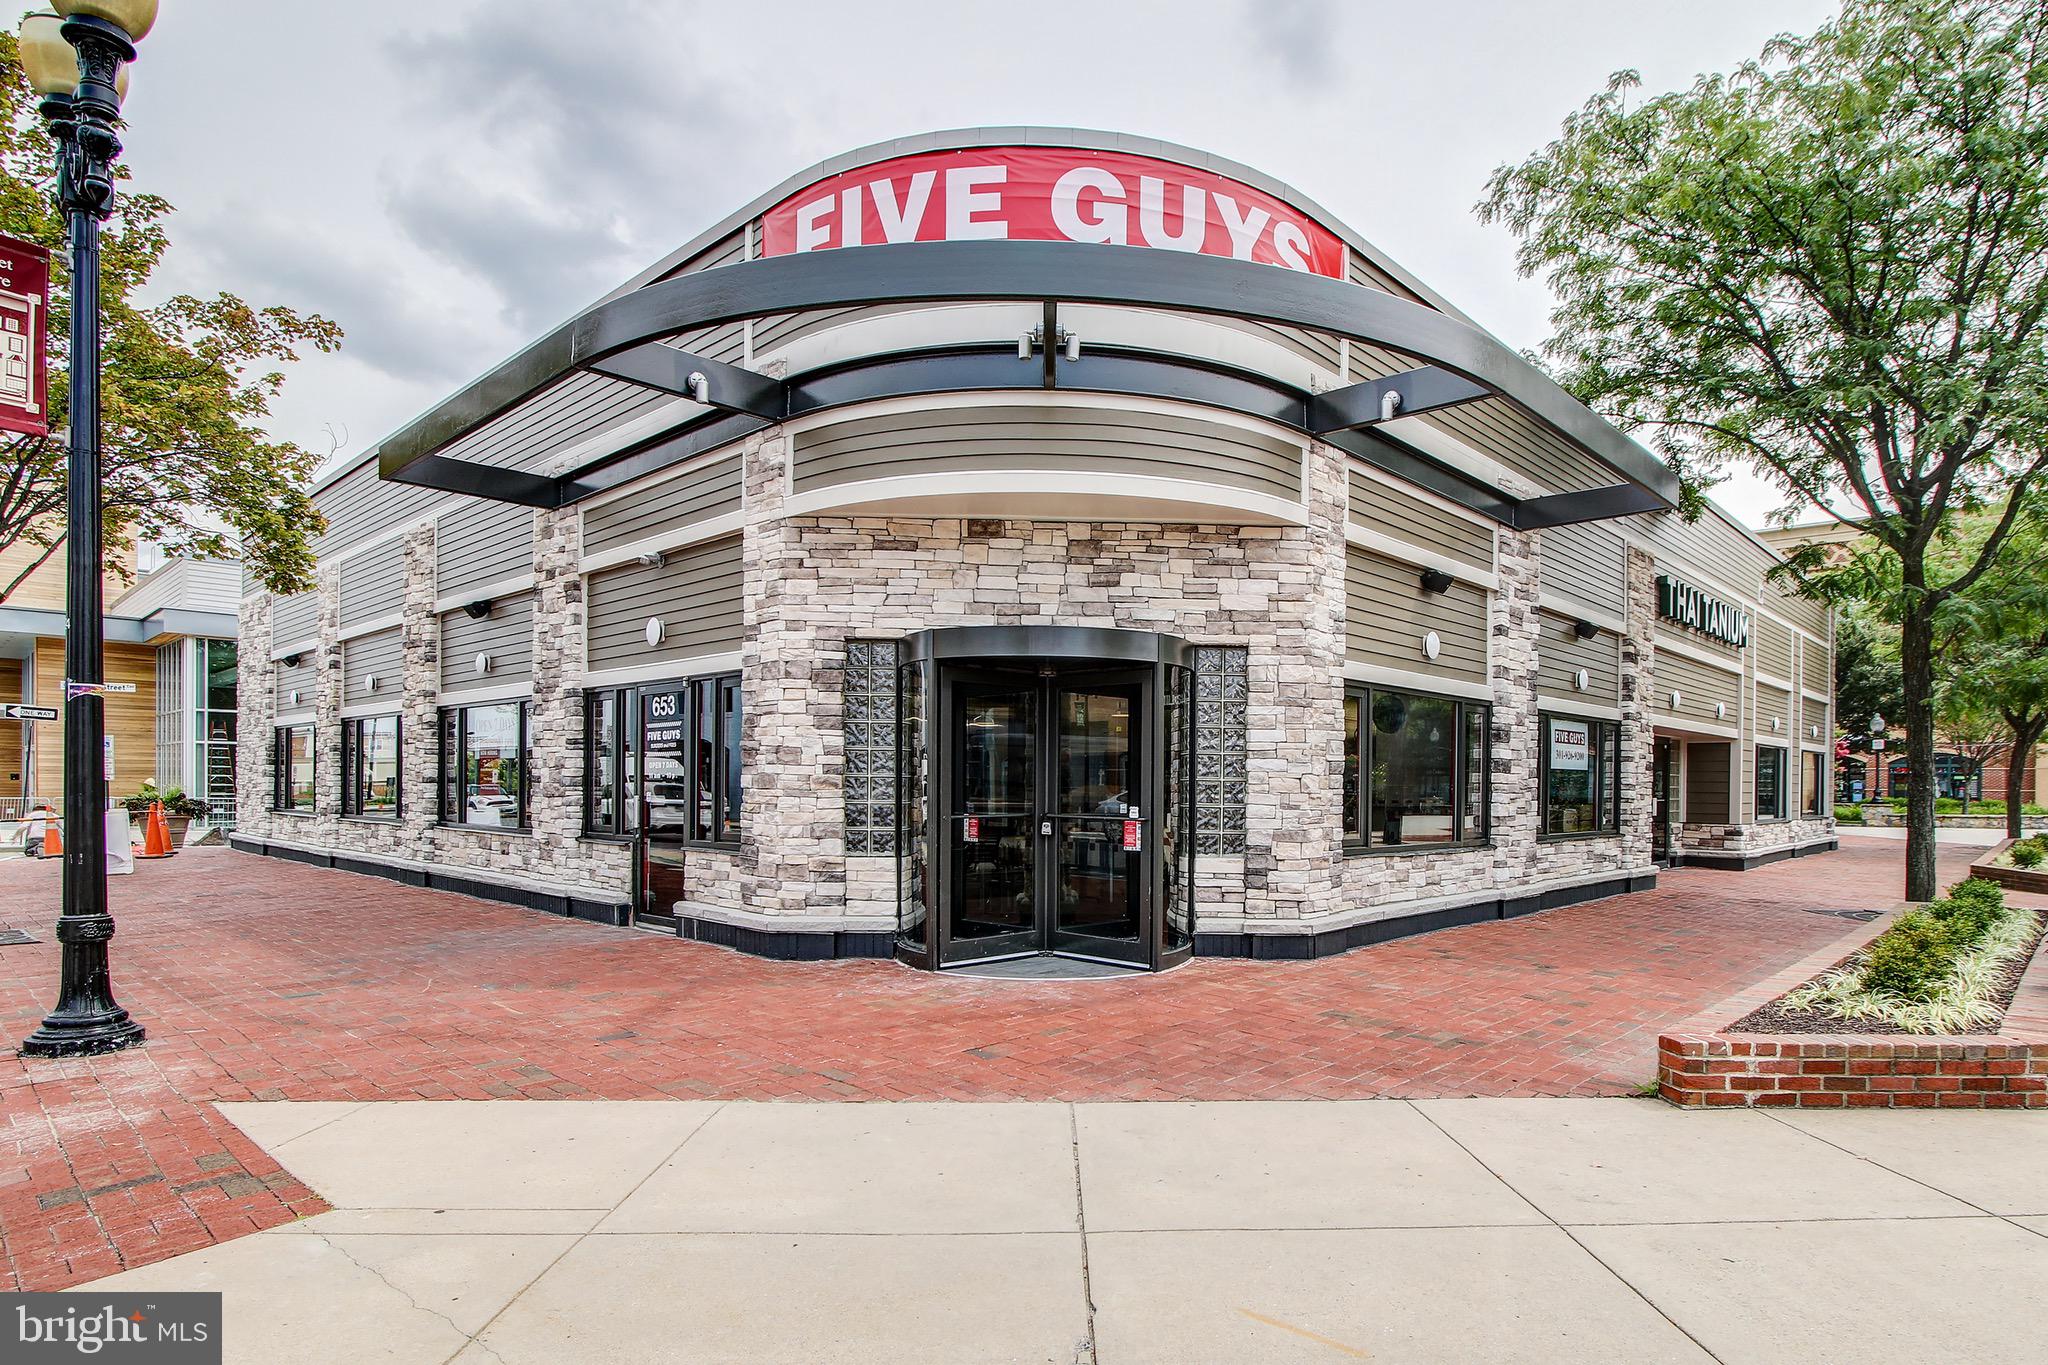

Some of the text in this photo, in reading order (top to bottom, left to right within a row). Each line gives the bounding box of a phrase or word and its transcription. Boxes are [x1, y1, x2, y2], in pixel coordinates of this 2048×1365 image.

[796, 165, 1312, 273] FIVE GUYS
[1662, 575, 1749, 648] THAI TANIUM
[20, 709, 34, 717] ONE
[652, 695, 676, 717] 653
[647, 729, 681, 741] FIVE GUYS
[1555, 730, 1585, 745] FIVE GUYS
